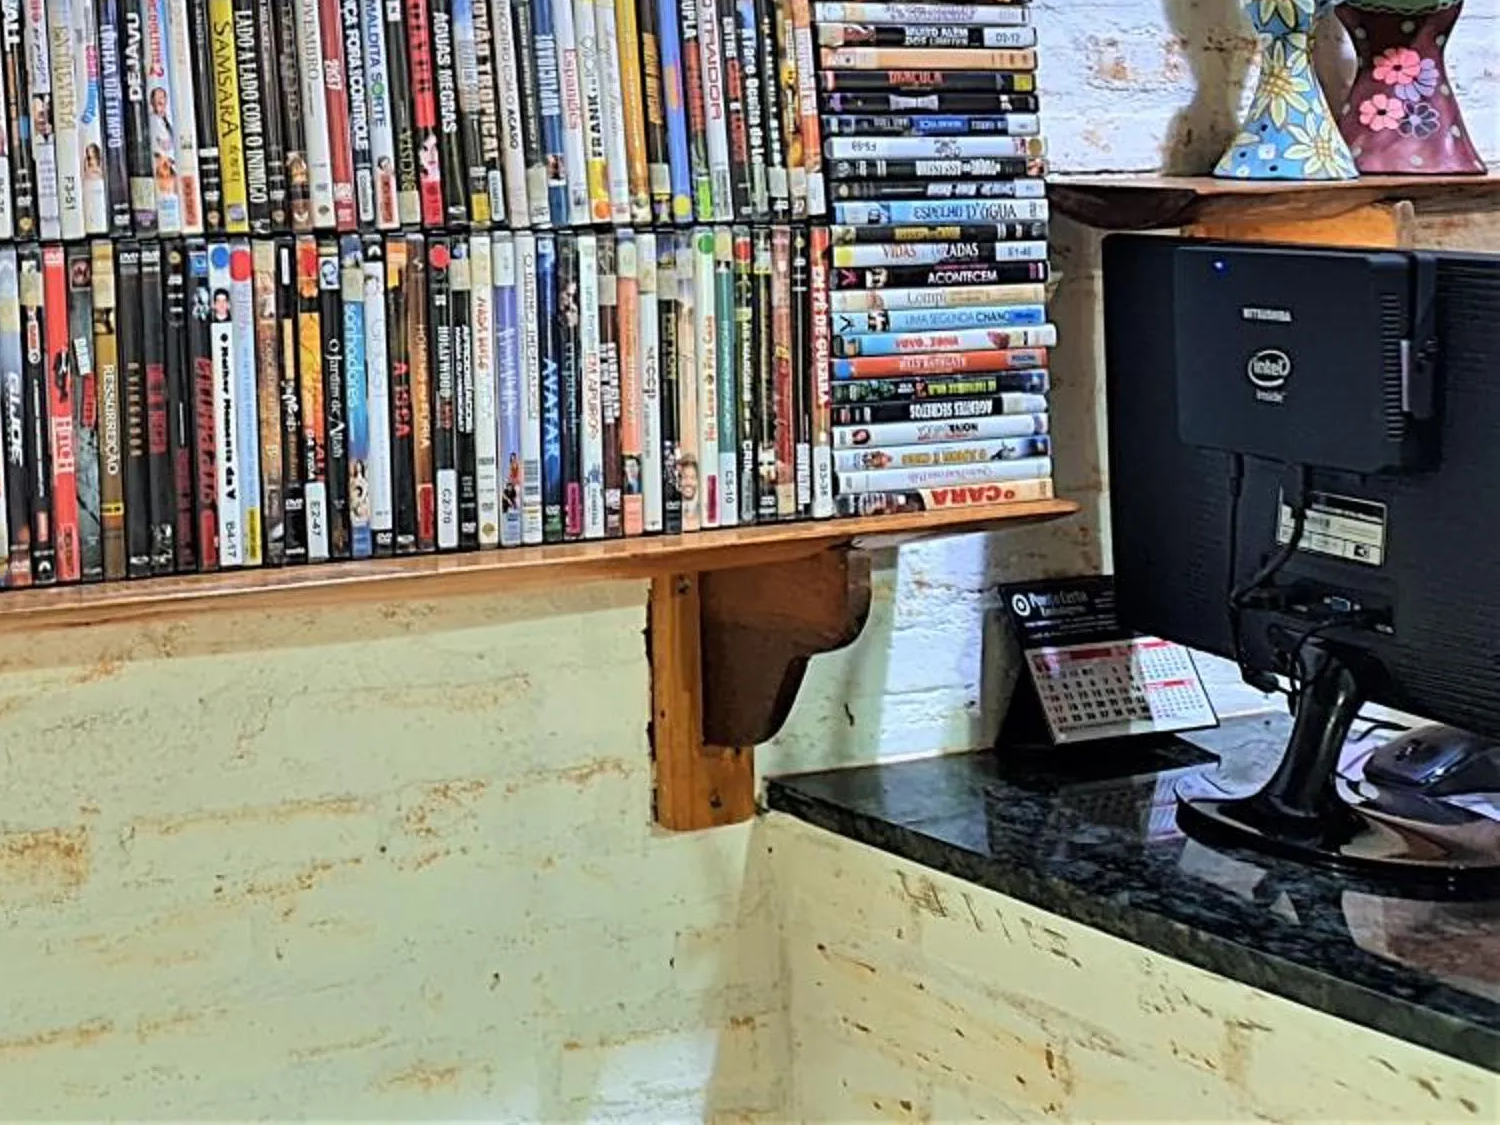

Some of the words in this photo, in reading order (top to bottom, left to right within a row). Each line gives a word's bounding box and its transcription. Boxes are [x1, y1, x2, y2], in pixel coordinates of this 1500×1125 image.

[235, 11, 255, 48] LADO
[366, 0, 382, 68] MALDITA
[212, 21, 237, 139] SAMSARA
[238, 63, 259, 101] LADO
[370, 72, 387, 128] SORTE
[240, 103, 261, 134] COM
[507, 109, 520, 149] ACASO
[245, 150, 267, 203] INIMIGO
[815, 338, 829, 405] GUERRA
[103, 364, 120, 475] RESSURREIÇÃO
[542, 358, 559, 462] AVATAR
[931, 485, 1002, 507] CARA
